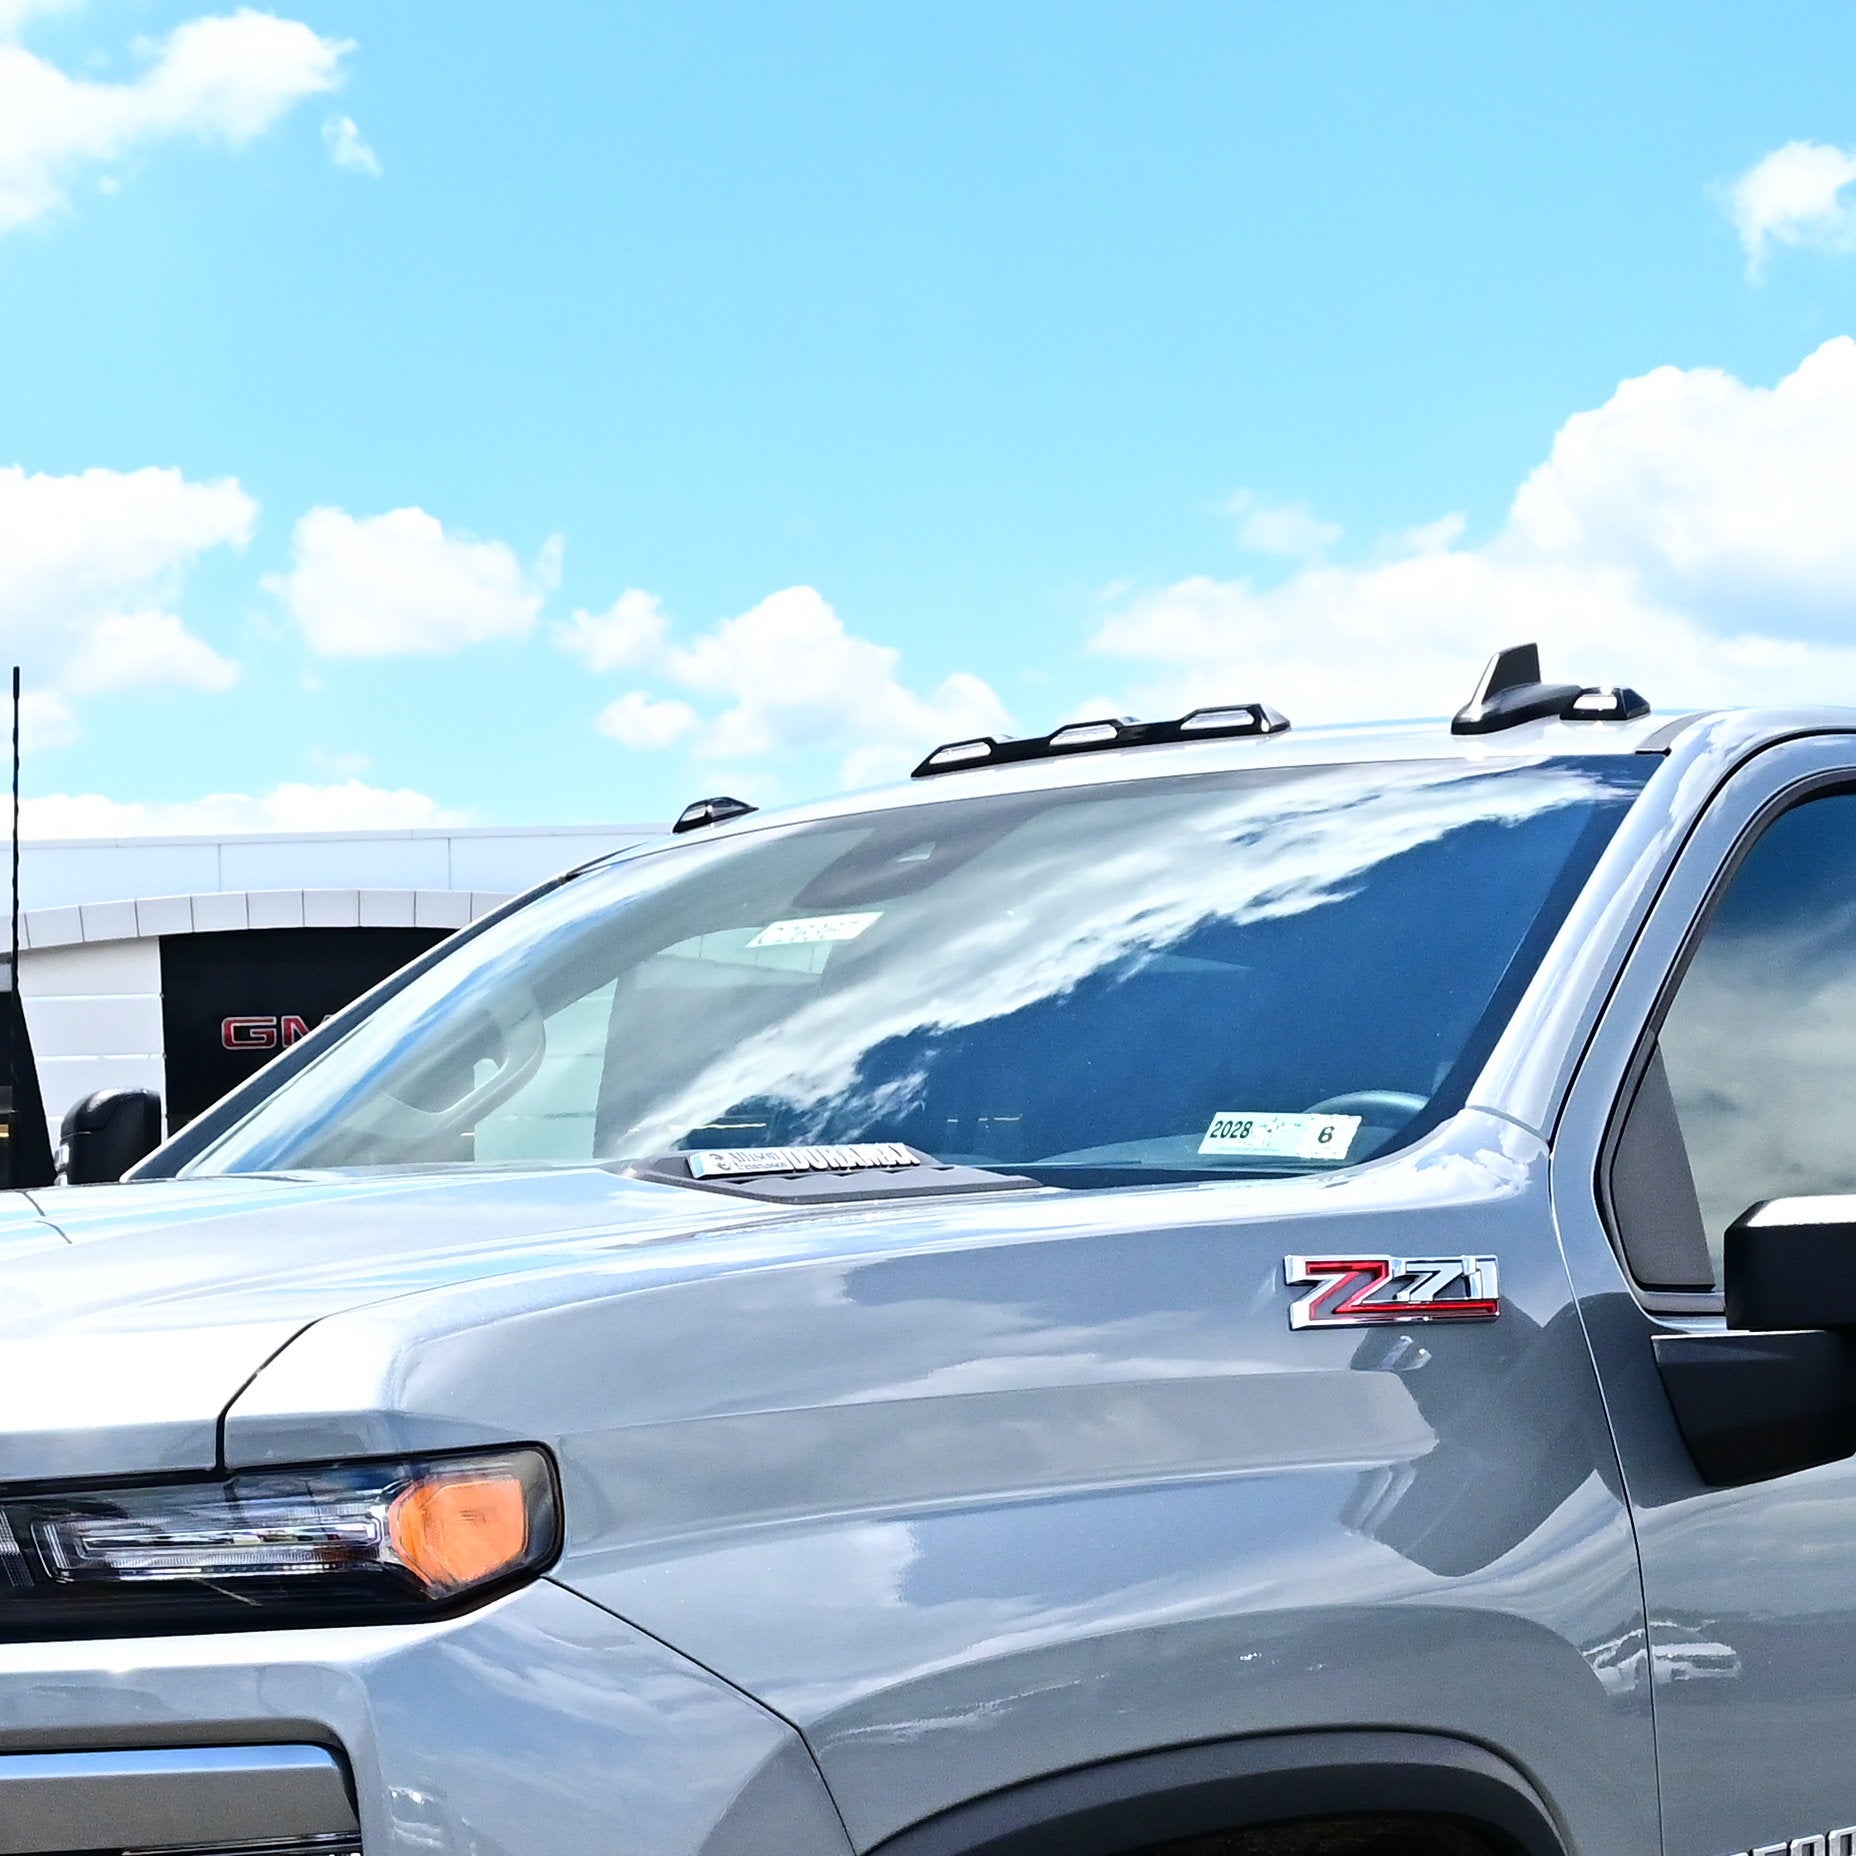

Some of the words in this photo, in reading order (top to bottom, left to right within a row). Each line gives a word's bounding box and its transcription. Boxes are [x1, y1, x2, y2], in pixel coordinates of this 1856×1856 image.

[1209, 1120, 1254, 1139] 2028
[1317, 1126, 1336, 1144] 6
[785, 1142, 921, 1171] DURAMAX
[1284, 1253, 1501, 1330] Z71
